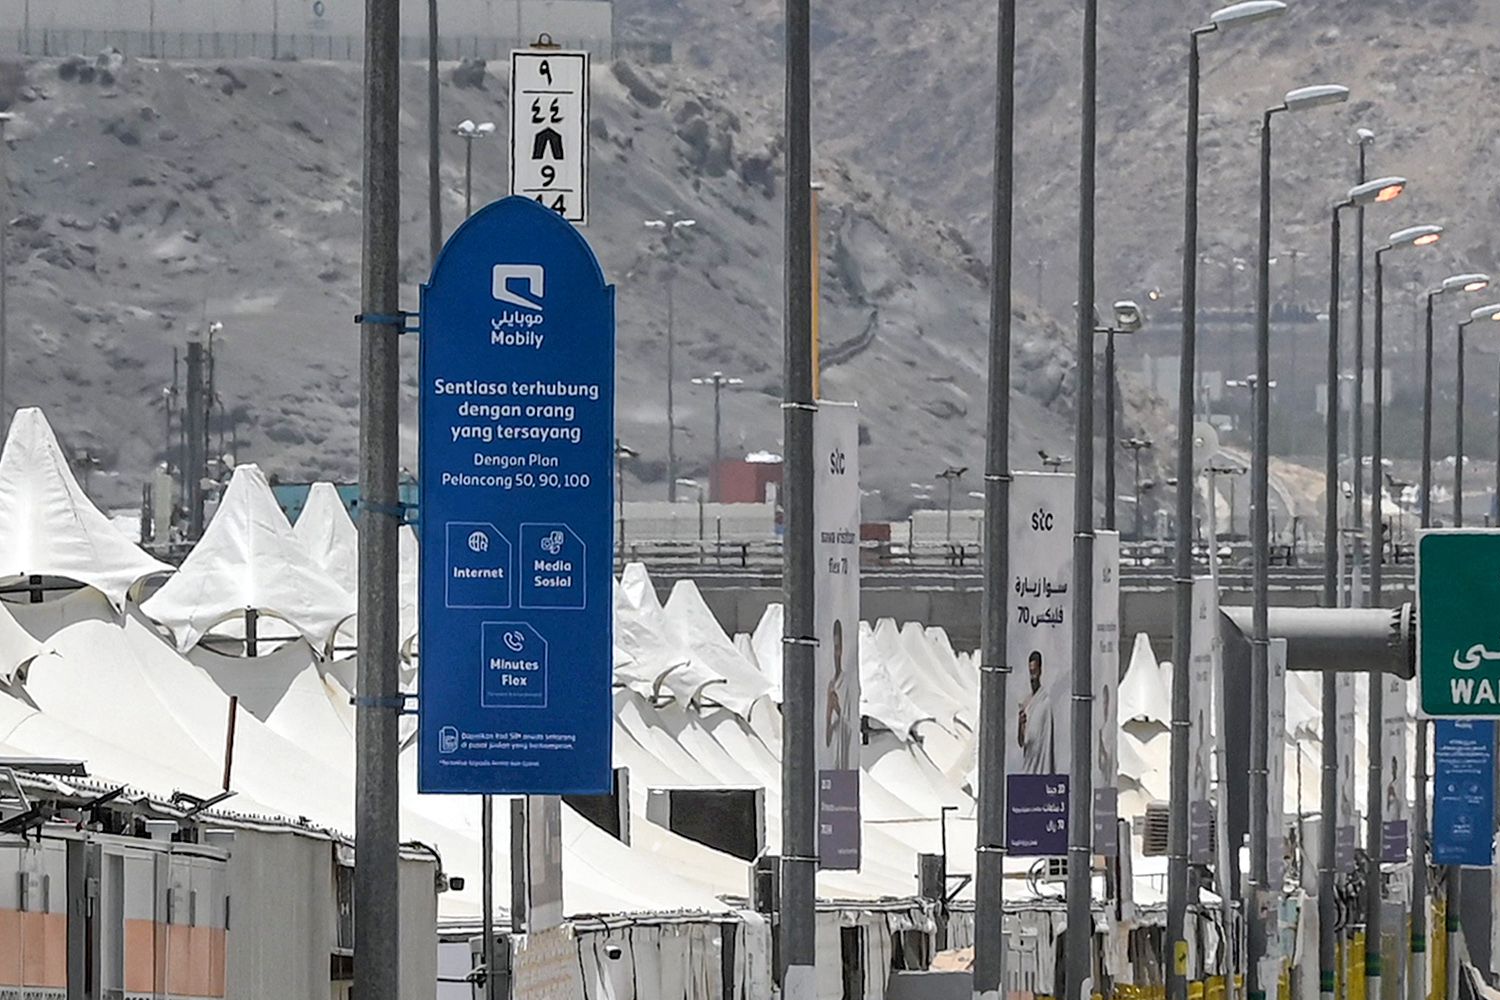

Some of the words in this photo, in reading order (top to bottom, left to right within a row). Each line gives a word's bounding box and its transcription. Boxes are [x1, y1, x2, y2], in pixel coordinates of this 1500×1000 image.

[539, 60, 553, 85] ٩
[531, 98, 564, 124] ٤٤
[540, 165, 556, 187] 9
[491, 311, 543, 330] موبايلي
[491, 330, 544, 349] Mobily
[434, 379, 508, 396] Sentiasa
[512, 381, 599, 399] terhubung
[458, 402, 522, 420] dengan
[526, 405, 575, 420] orang
[451, 426, 492, 442] yang
[497, 425, 581, 443] tersayang
[474, 454, 525, 468] Dengan
[528, 453, 559, 467] Plan
[829, 448, 846, 475] stc
[442, 473, 513, 489] Pelancong
[515, 474, 537, 489] 50,
[538, 474, 562, 489] 90,
[564, 474, 590, 488] 100
[1031, 508, 1054, 531] stc
[453, 567, 504, 579] Internet
[534, 560, 572, 572] Media
[534, 575, 572, 588] Sosial
[1015, 576, 1042, 597] زيارة
[1043, 577, 1068, 597] سوا
[1017, 606, 1029, 624] 70
[1031, 605, 1064, 628] فليكس
[490, 658, 539, 671] Minutes
[501, 674, 528, 687] Flex
